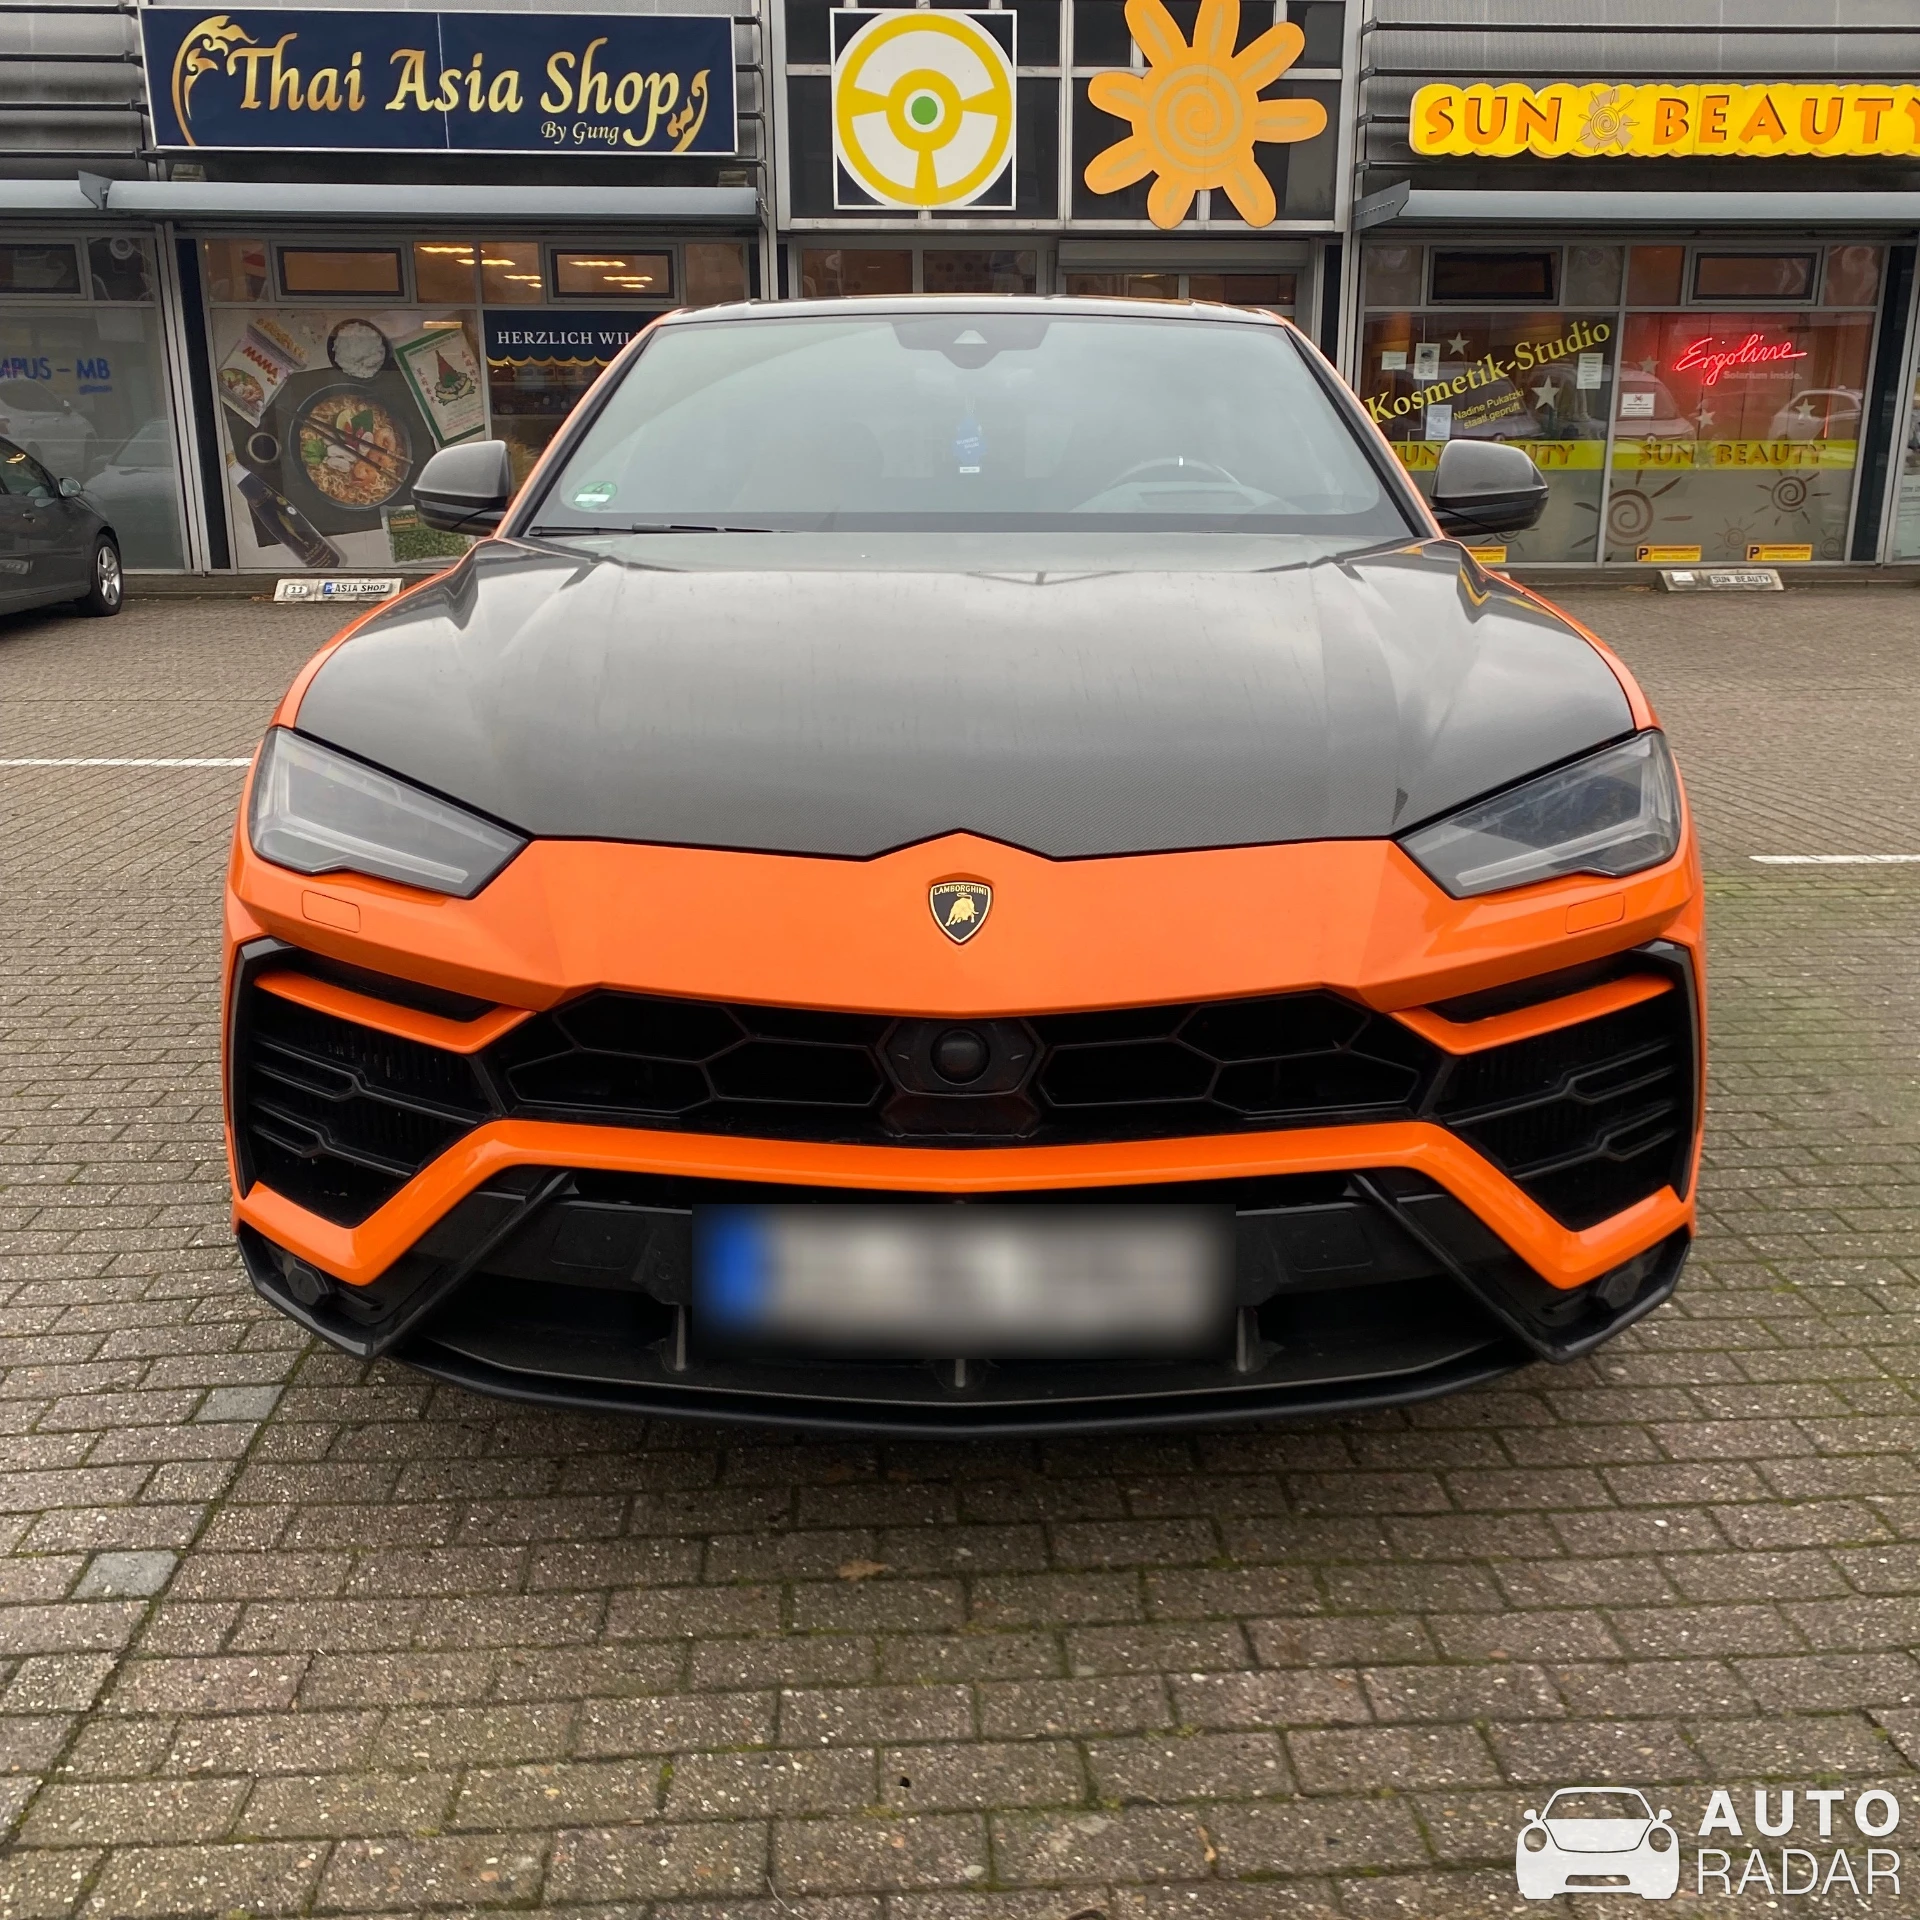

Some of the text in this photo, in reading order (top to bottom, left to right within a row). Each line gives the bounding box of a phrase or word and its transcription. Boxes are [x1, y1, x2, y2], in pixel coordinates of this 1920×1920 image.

[226, 32, 680, 147] Thai Asia Shop
[1424, 96, 1562, 145] SUN
[541, 121, 619, 146] By Gung
[497, 331, 641, 345] HERZLICH WIL
[1676, 333, 1808, 386] Ergoline
[1364, 320, 1610, 424] Kosmetik-Studio
[1723, 371, 1767, 380] Solarium
[1453, 404, 1485, 420] Nadine
[1393, 444, 1441, 466] UN
[1638, 443, 1827, 466] SUN BEAUTY
[1638, 548, 1649, 560] P
[1749, 546, 1760, 558] P
[1712, 574, 1769, 583] SUN BEAUTY
[335, 584, 358, 593] ASIA
[360, 583, 386, 592] SHOP
[934, 884, 987, 896] LAMBORGHINI
